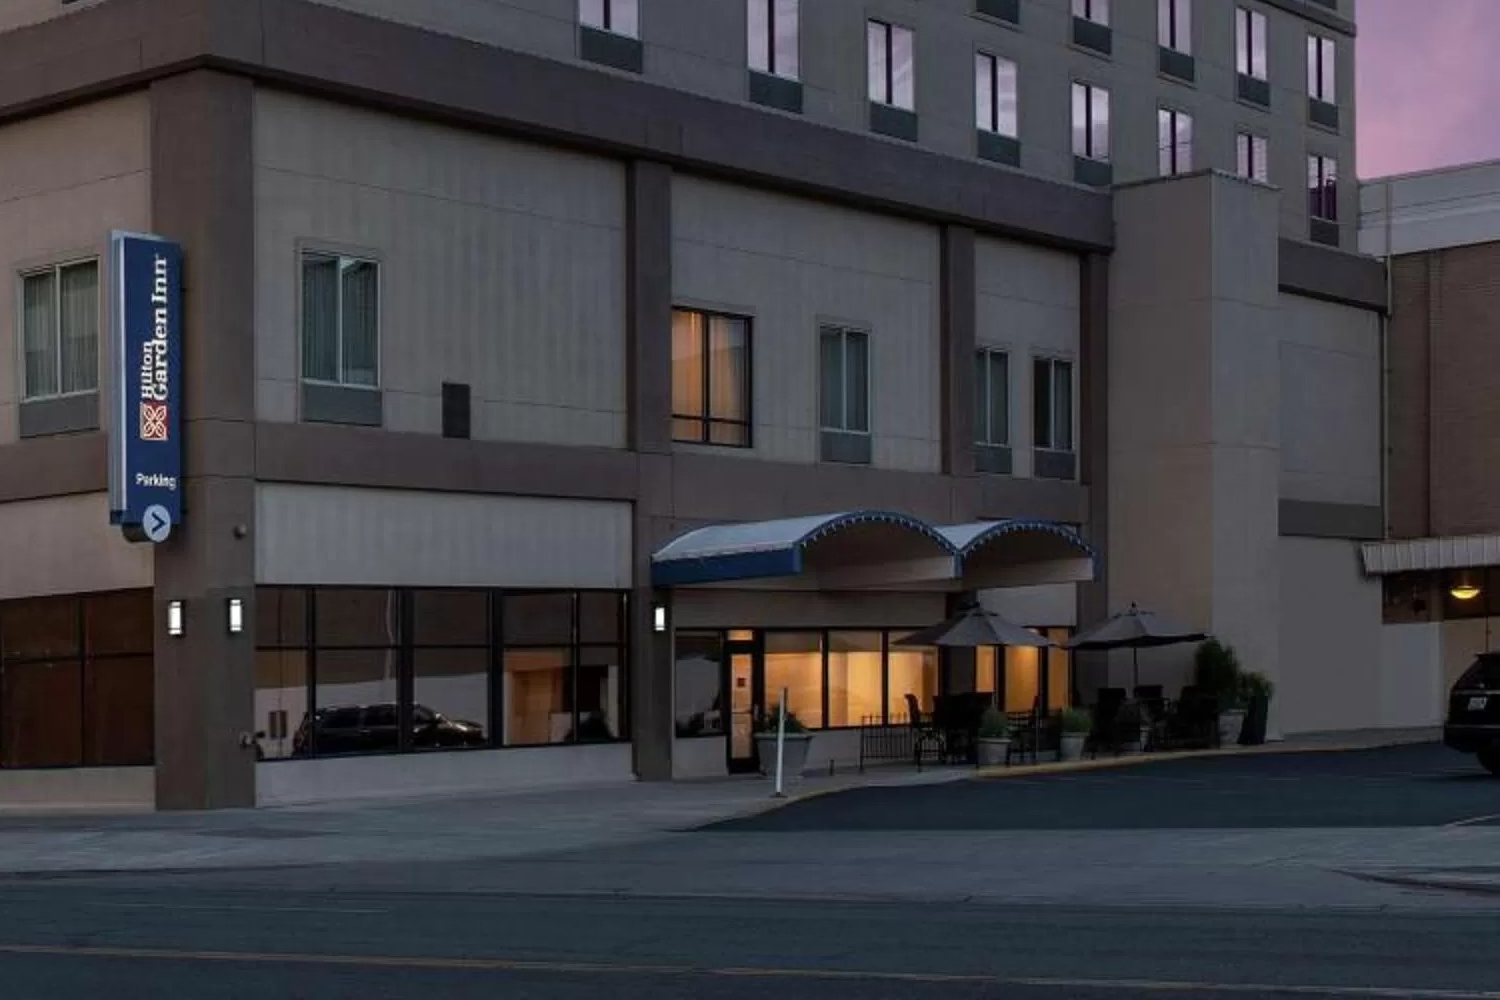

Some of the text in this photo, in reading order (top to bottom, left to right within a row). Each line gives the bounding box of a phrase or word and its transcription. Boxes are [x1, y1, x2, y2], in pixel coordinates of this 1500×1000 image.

[151, 256, 168, 401] Garden Inn
[141, 341, 153, 399] Hilton
[135, 472, 177, 491] Parking
